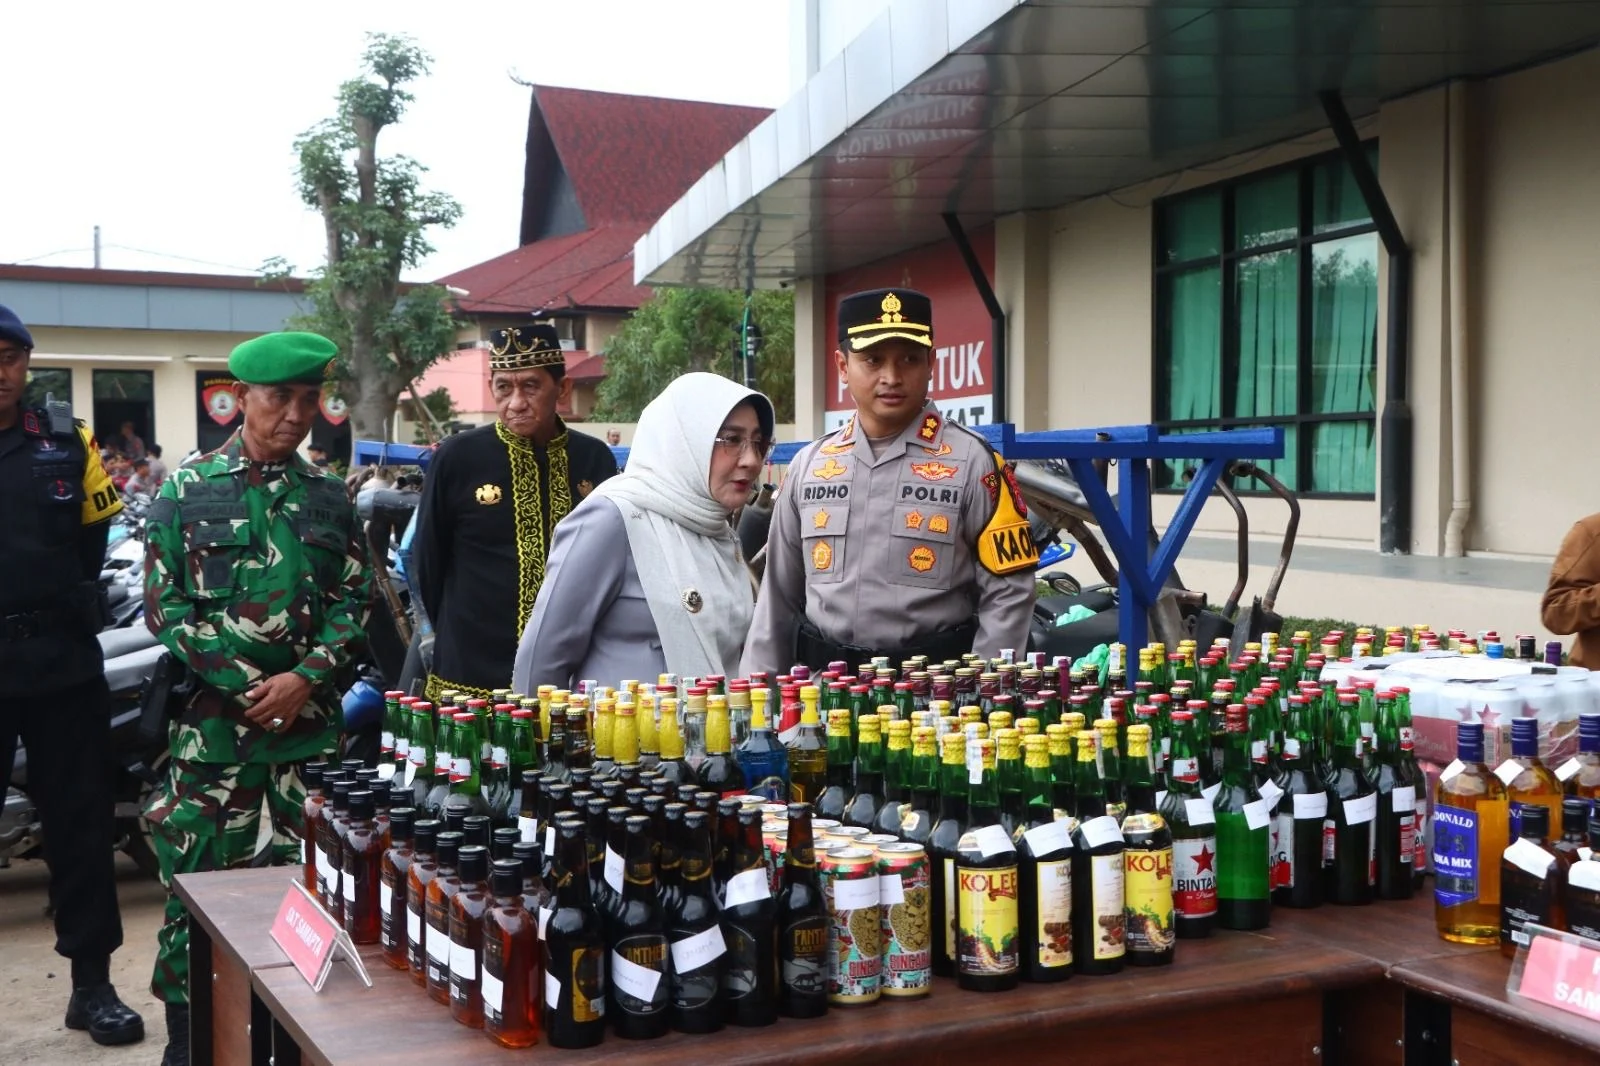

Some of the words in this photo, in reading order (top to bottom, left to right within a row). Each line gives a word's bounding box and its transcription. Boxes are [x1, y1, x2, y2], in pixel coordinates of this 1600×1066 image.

[928, 341, 985, 393] TUK
[93, 484, 118, 512] DA
[804, 484, 849, 502] RIDHO
[901, 485, 958, 505] POLRI
[1451, 857, 1473, 869] MIX
[1554, 981, 1600, 1013] SAM
